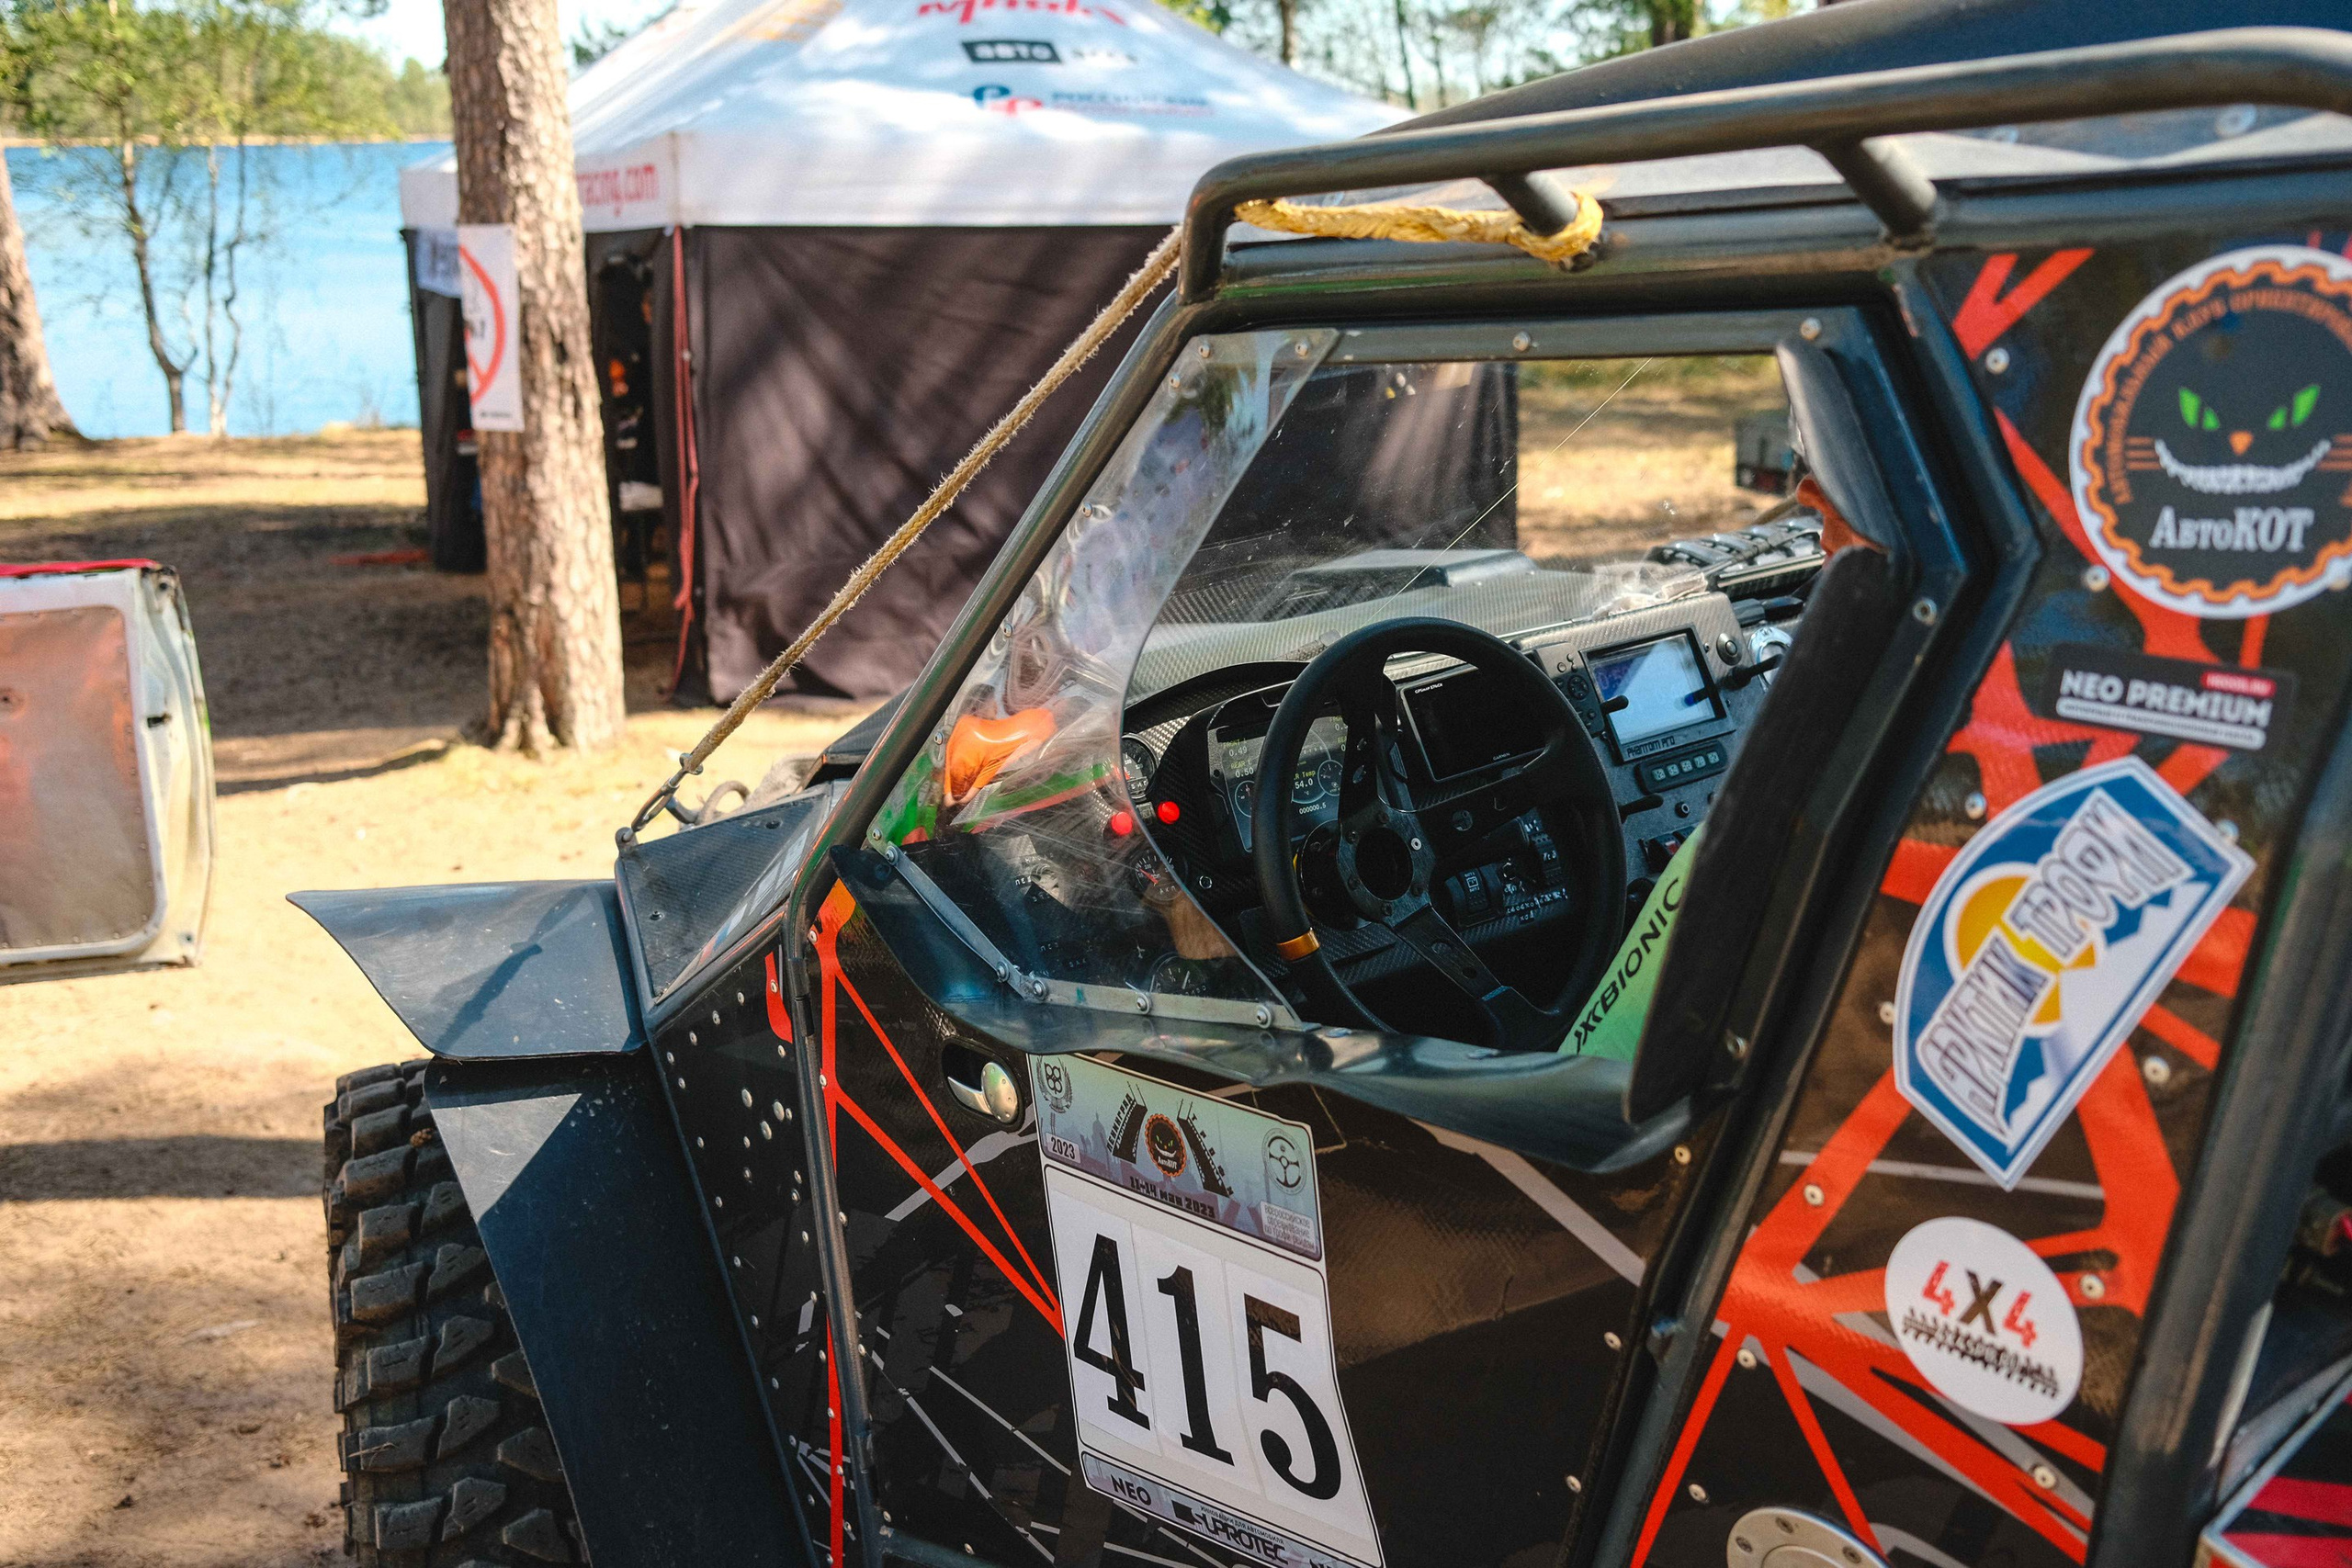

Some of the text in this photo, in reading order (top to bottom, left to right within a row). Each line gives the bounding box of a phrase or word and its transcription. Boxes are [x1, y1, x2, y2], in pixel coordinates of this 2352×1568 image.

[2061, 669, 2124, 704] NEO
[2126, 678, 2274, 728] PREMIUM
[1228, 745, 1248, 757] 0.49
[1235, 767, 1255, 778] 0.50
[1295, 777, 1314, 790] 54.0
[1298, 803, 1328, 815] 000000.5
[2003, 790, 2194, 963] ТРОФИ
[1106, 1093, 1133, 1154] ЛЕНИНГРАД
[1051, 1136, 1076, 1159] 2023
[1130, 1176, 1158, 1198] 11-14
[1184, 1196, 1216, 1219] 2023
[1073, 1233, 1342, 1501] 415
[1110, 1473, 1152, 1506] NEO
[1185, 1505, 1289, 1565] SUPROTEC
